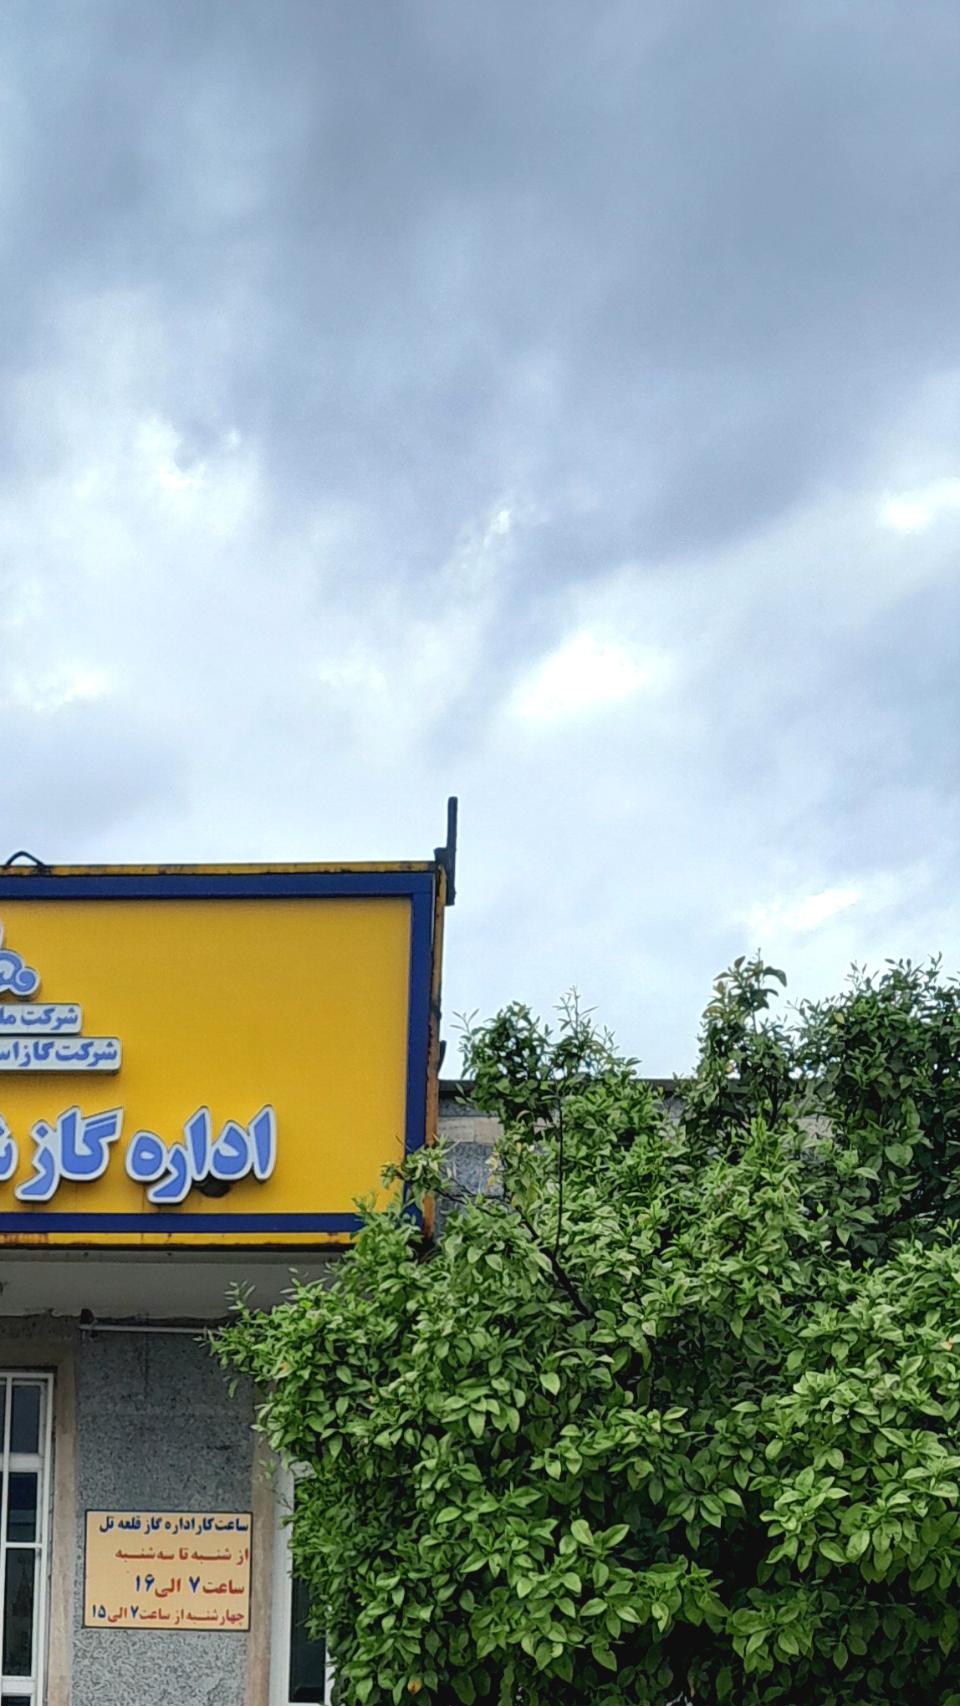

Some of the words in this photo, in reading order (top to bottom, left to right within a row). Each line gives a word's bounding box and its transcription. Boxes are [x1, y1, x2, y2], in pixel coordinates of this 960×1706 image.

[20, 1006, 79, 1030] شرکت
[54, 1041, 118, 1067] شرکت
[15, 1105, 123, 1201] گاز
[126, 1105, 276, 1203] اداره
[99, 1515, 114, 1532] تل
[118, 1515, 142, 1530] قلعه
[144, 1516, 163, 1534] گاز
[165, 1517, 195, 1535] اداره
[196, 1517, 215, 1535] کار
[214, 1517, 249, 1531] ساعت
[178, 1547, 189, 1560] تا
[191, 1547, 232, 1565] شنبه
[236, 1547, 249, 1566] از
[155, 1577, 182, 1598] الی
[188, 1575, 201, 1594] ۷
[202, 1579, 245, 1595] ساعت
[92, 1604, 107, 1618] ۱۵
[107, 1606, 128, 1623] الی
[130, 1604, 139, 1618] ۷
[139, 1607, 171, 1620] ساعت
[174, 1608, 185, 1625] از
